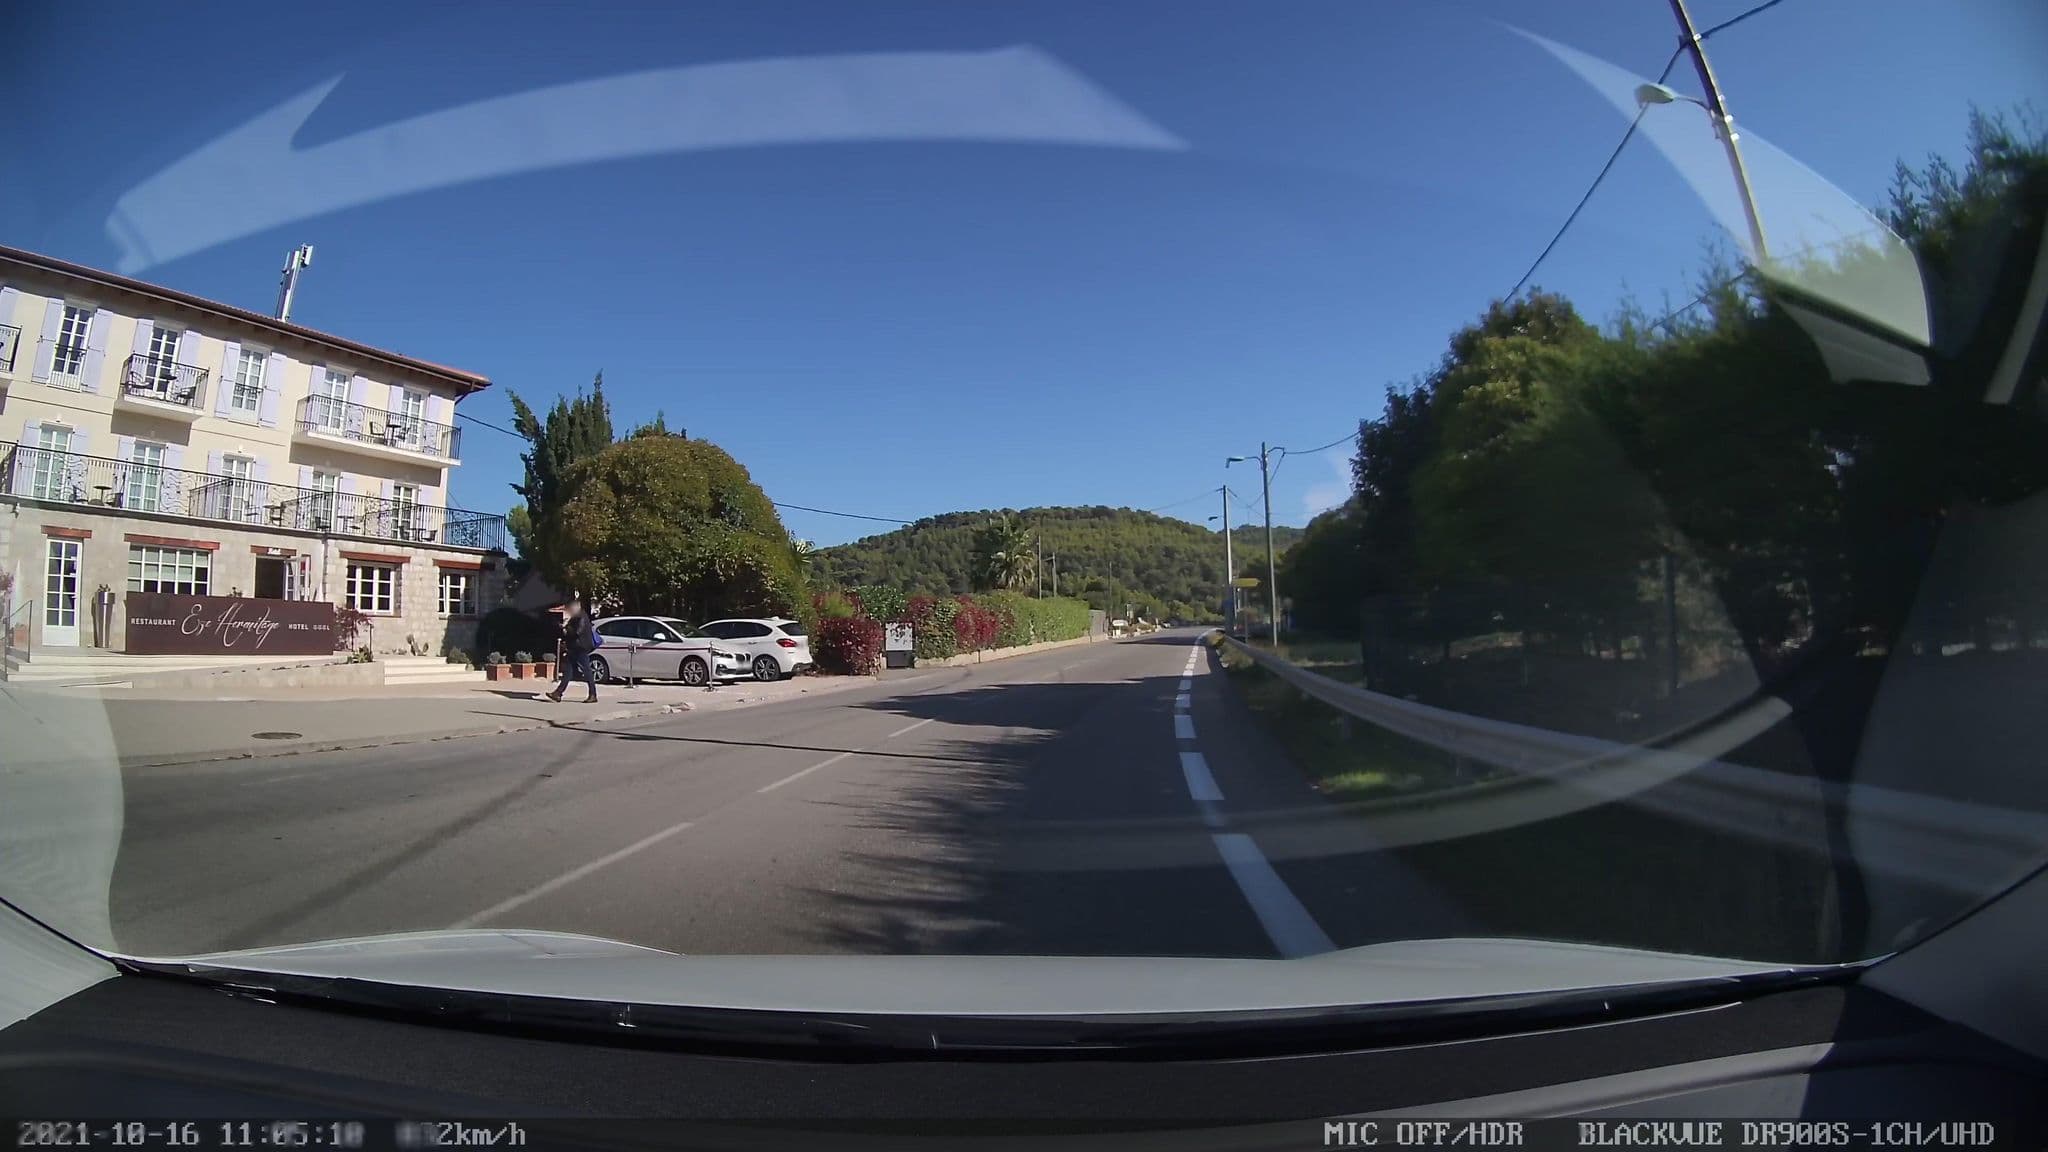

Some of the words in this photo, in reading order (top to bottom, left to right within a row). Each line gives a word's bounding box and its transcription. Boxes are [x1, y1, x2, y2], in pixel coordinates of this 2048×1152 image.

[131, 617, 176, 626] RESTAURANT
[181, 603, 212, 636] Eze
[215, 602, 280, 649] Hermitage
